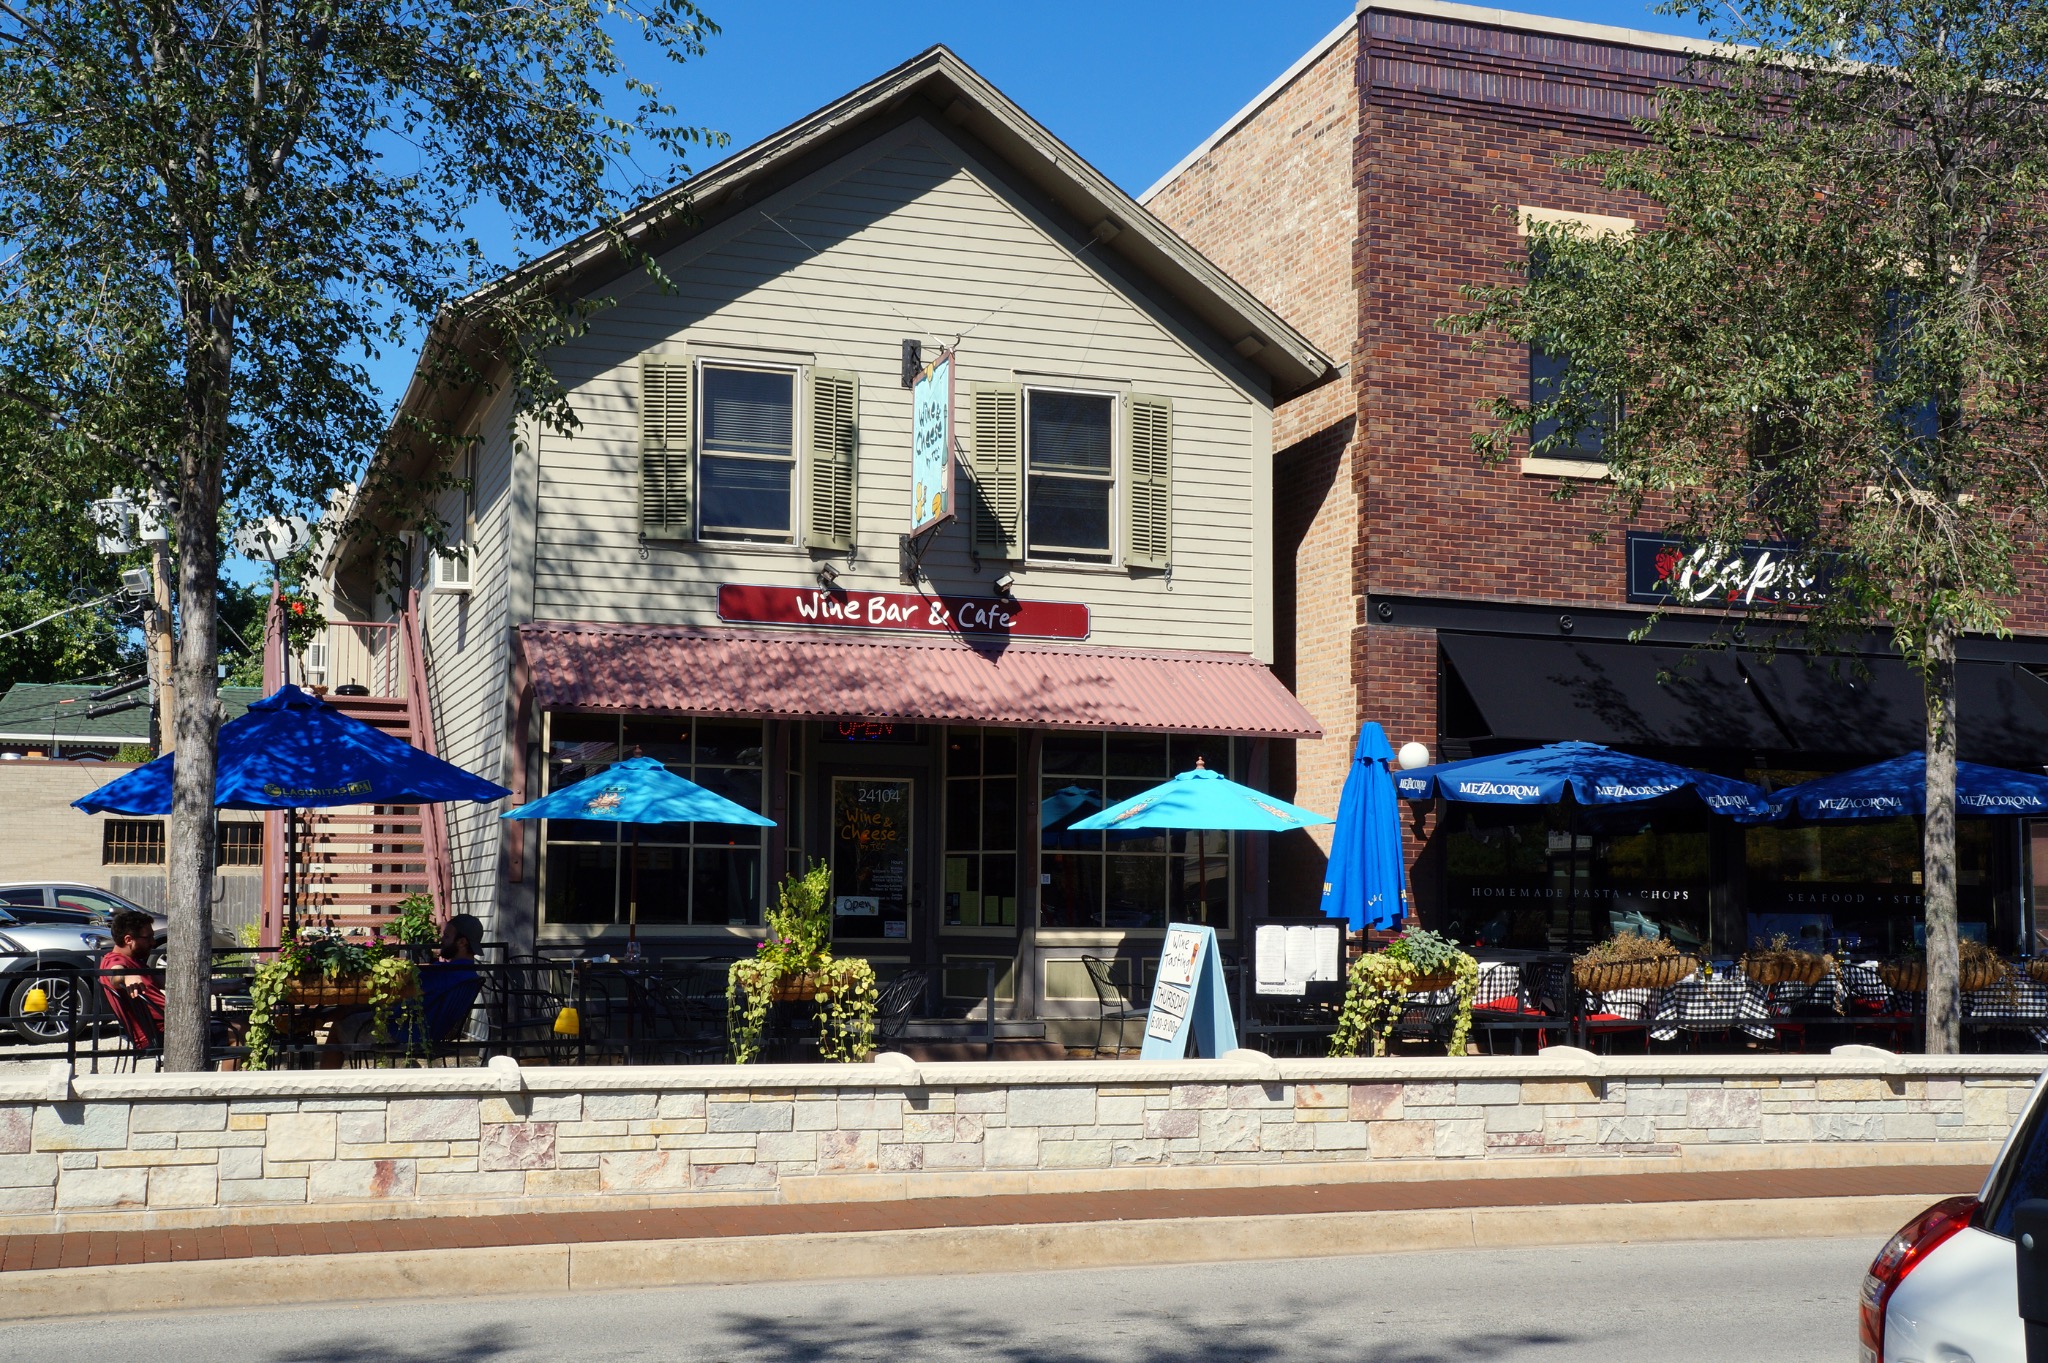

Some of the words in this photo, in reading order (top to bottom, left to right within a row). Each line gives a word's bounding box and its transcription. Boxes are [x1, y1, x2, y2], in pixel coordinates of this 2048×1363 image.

[916, 421, 942, 456] Cheese
[796, 592, 861, 620] Wine
[867, 596, 919, 625] Bar
[928, 601, 950, 626] &
[958, 602, 1017, 629] Cafe
[283, 787, 347, 796] LAGUNITAS
[857, 788, 901, 803] 24104
[1459, 782, 1540, 799] MEZZACORONA
[1819, 797, 1903, 811] MEZZACORONA
[1959, 794, 2042, 810] MEZZACORONA
[846, 807, 881, 824] Wine
[883, 817, 893, 828] &
[841, 824, 897, 841] Cheese
[1472, 887, 1563, 898] HOMEMADE
[1574, 890, 1620, 899] PASTA
[1640, 890, 1690, 901] CHOPS
[1787, 893, 1865, 903] SEAFOOD
[1893, 895, 1923, 904] STE
[843, 899, 871, 912] Open
[1173, 934, 1190, 950] Wine
[1165, 953, 1190, 975] Tasting
[1156, 986, 1187, 1012] THURSDAY
